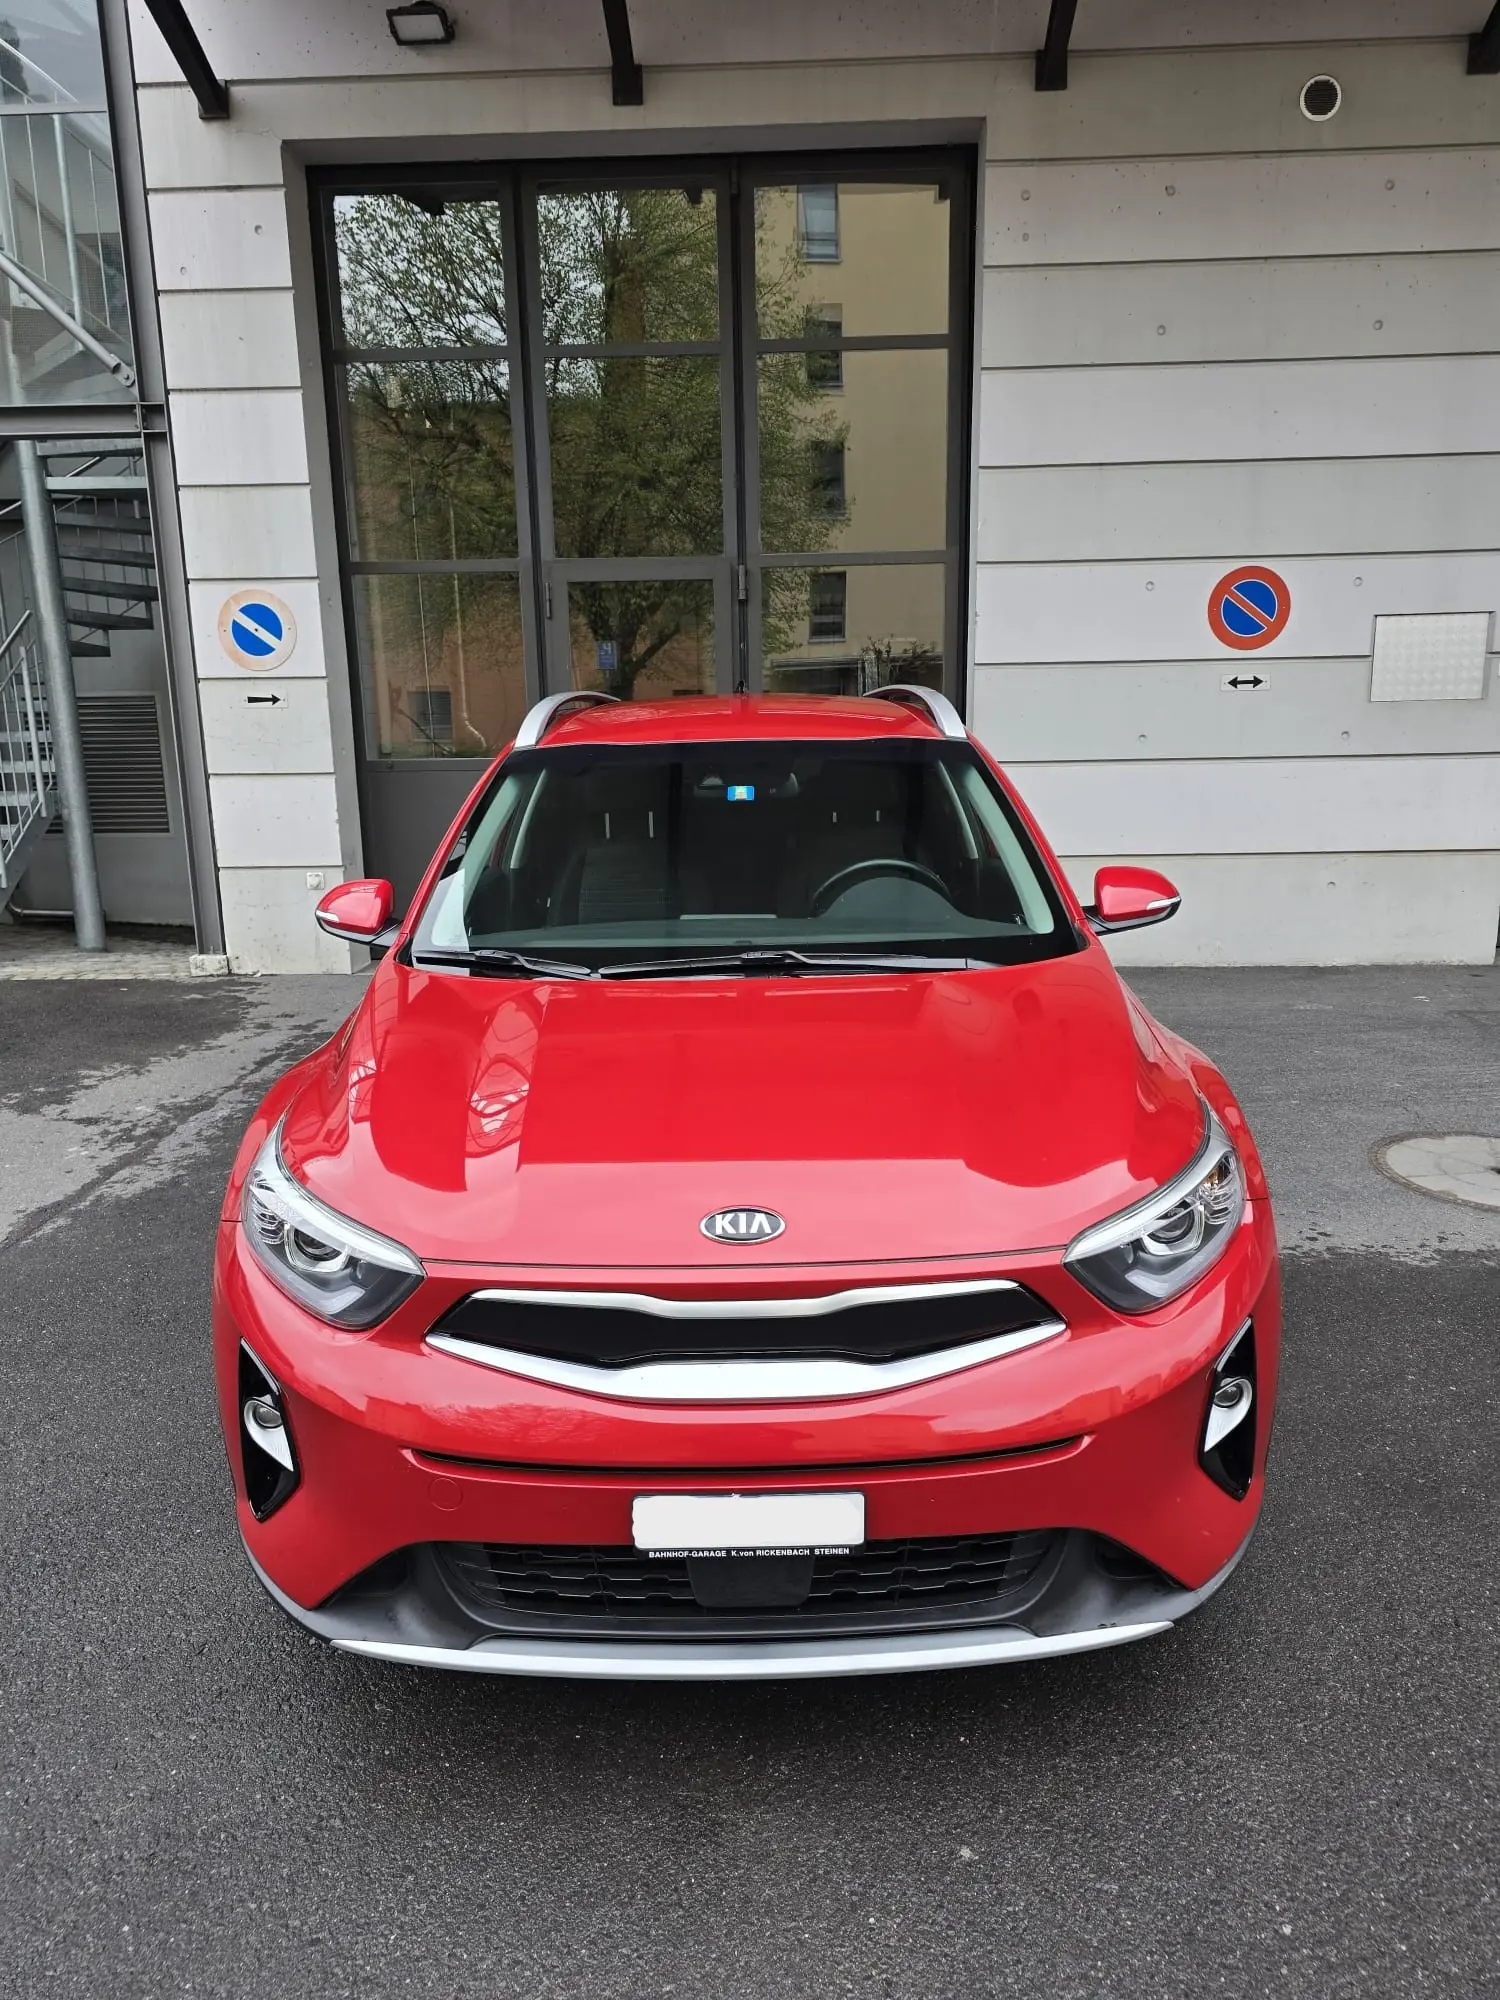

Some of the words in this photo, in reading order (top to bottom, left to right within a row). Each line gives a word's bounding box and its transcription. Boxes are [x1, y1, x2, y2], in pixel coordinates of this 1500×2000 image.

[715, 1212, 773, 1235] KIA
[648, 1550, 728, 1559] BAHNHOF-GARAGE
[756, 1548, 810, 1557] RICKENBACH
